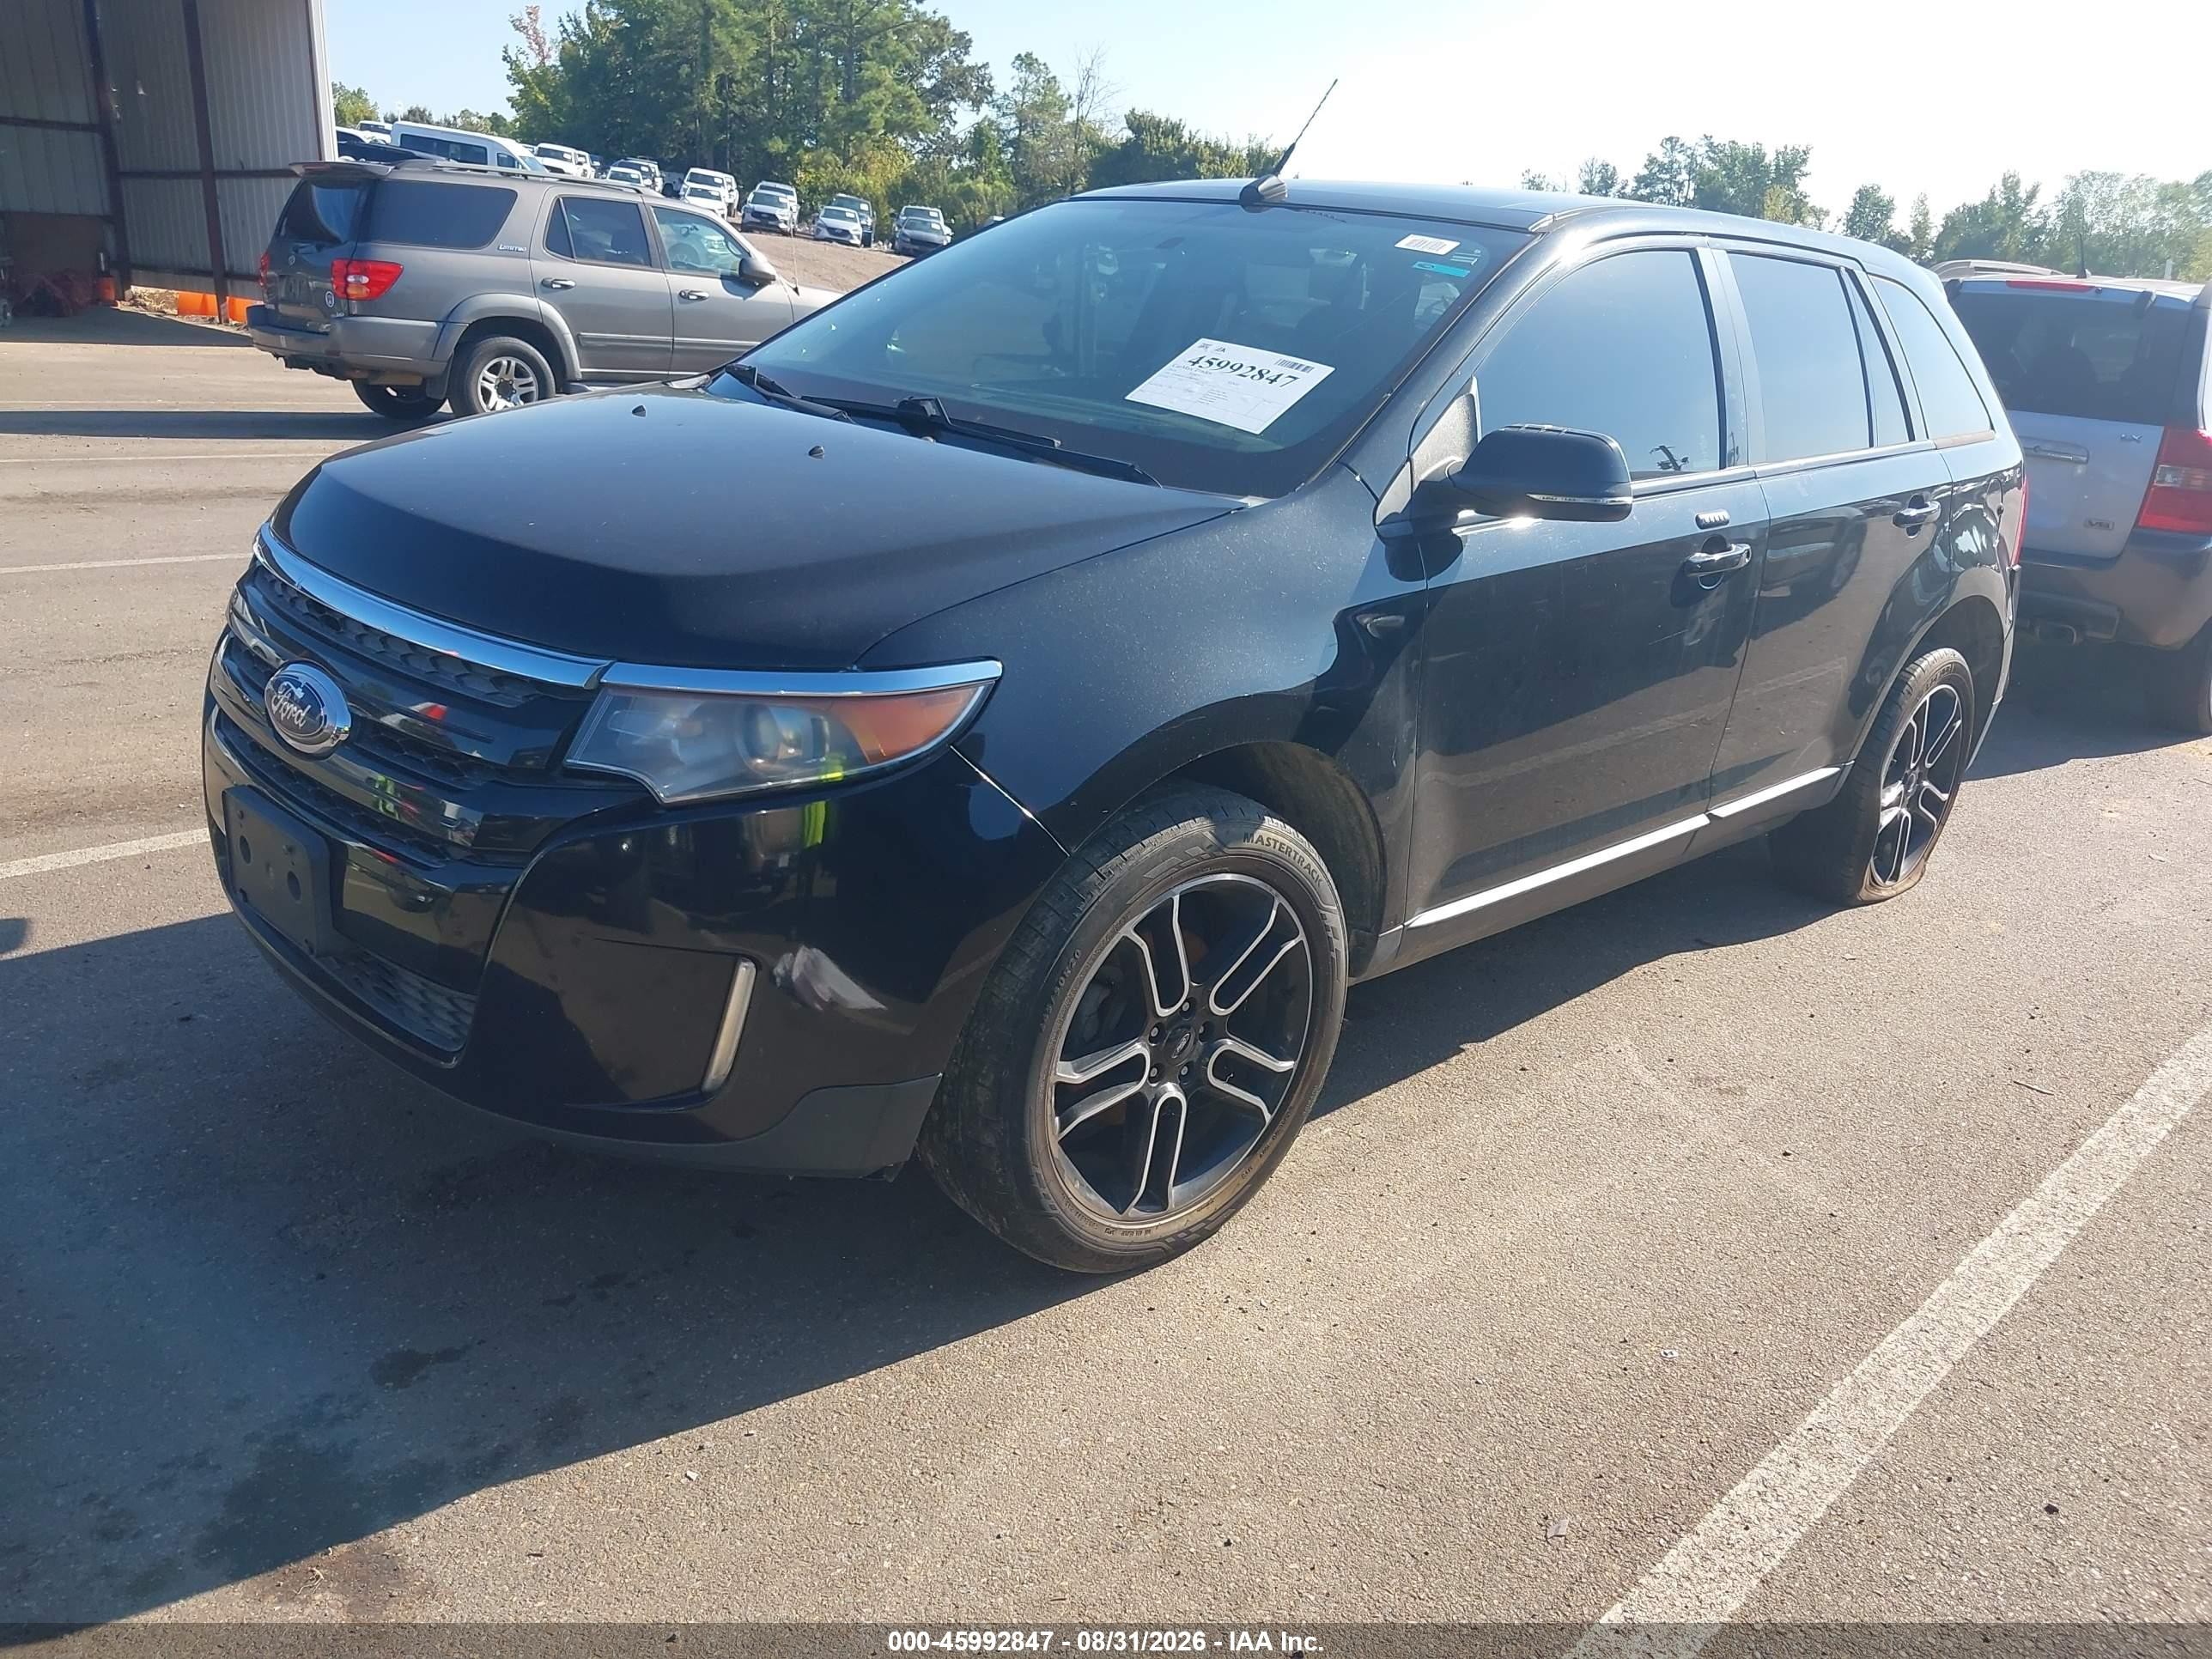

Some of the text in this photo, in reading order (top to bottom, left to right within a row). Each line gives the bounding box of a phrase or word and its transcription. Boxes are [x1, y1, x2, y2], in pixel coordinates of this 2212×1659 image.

[1188, 356, 1300, 387] 45992847
[270, 681, 312, 730] Ford
[1243, 831, 1324, 888] MASTERTRACK
